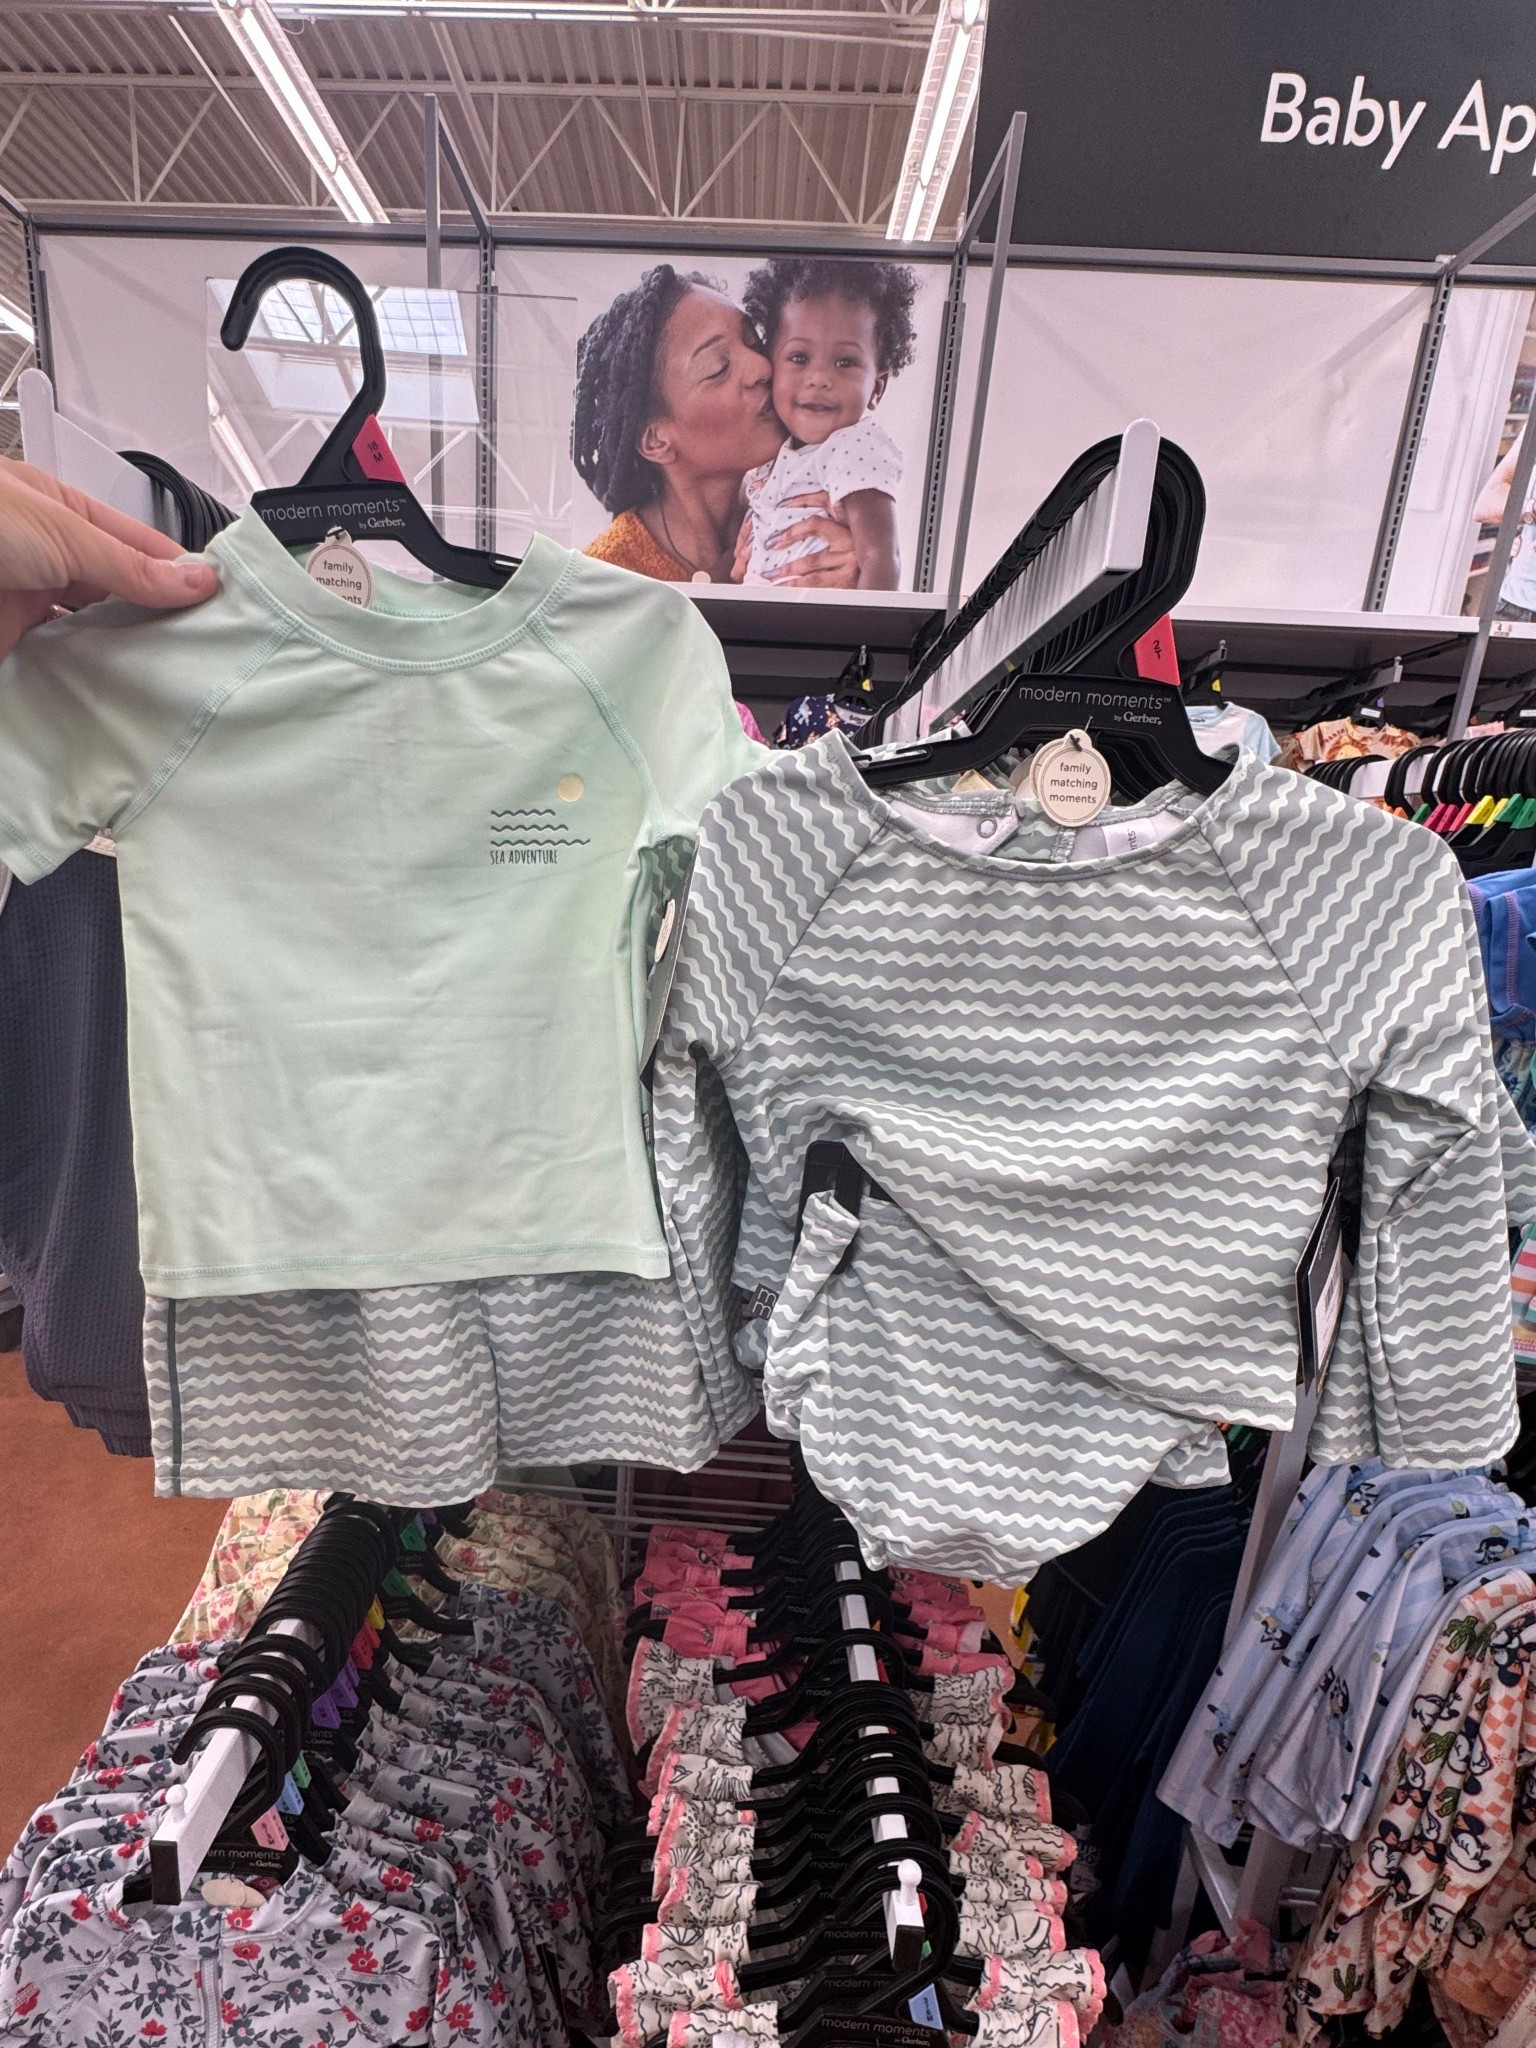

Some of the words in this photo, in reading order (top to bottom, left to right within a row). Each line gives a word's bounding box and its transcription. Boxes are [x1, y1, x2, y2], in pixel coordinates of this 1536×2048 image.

[1260, 72, 1427, 170] Baby
[1436, 79, 1536, 176] Ap
[261, 503, 323, 521] modern
[359, 521, 367, 530] by
[323, 560, 354, 575] family
[315, 577, 362, 591] matching
[1018, 686, 1081, 704] modern
[1114, 714, 1122, 722] by
[1059, 762, 1092, 775] family
[1050, 778, 1098, 791] matching
[1049, 793, 1097, 804] moments
[490, 850, 506, 866] SEA
[508, 849, 558, 865] ADVENTURE
[823, 1930, 868, 1940] modern
[821, 2018, 870, 2031] modern
